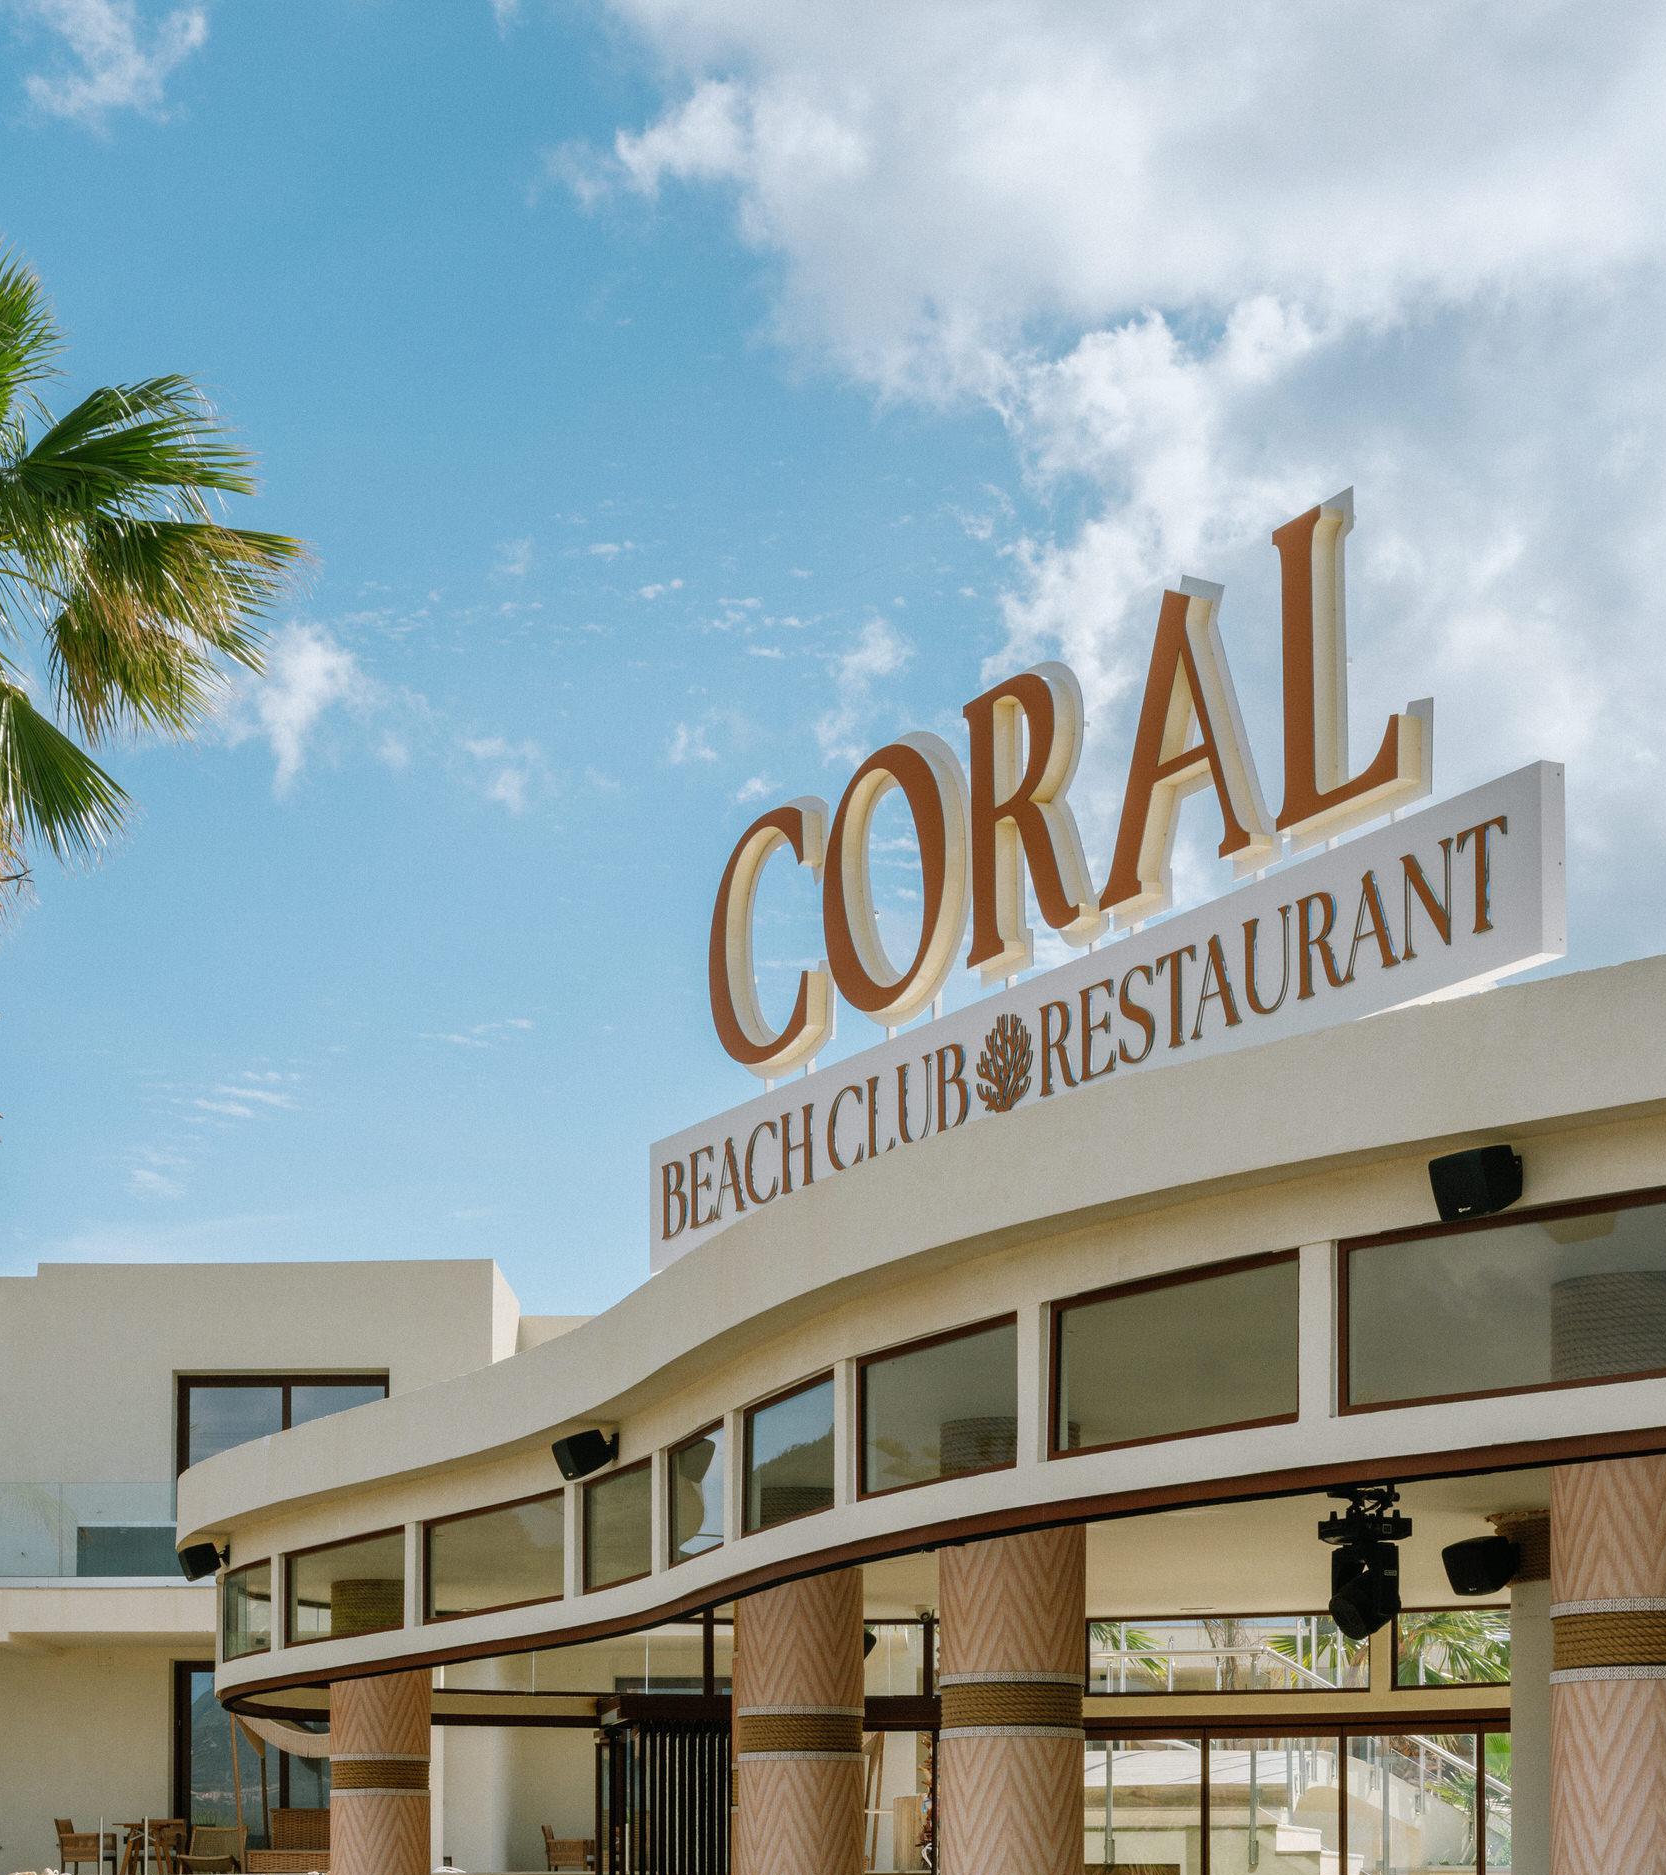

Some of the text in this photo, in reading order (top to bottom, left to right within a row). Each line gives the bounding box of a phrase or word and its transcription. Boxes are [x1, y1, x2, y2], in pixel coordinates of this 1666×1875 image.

[661, 814, 1509, 1241] BEACH CLUB RESTAURANT
[709, 503, 1411, 1068] CORAL
